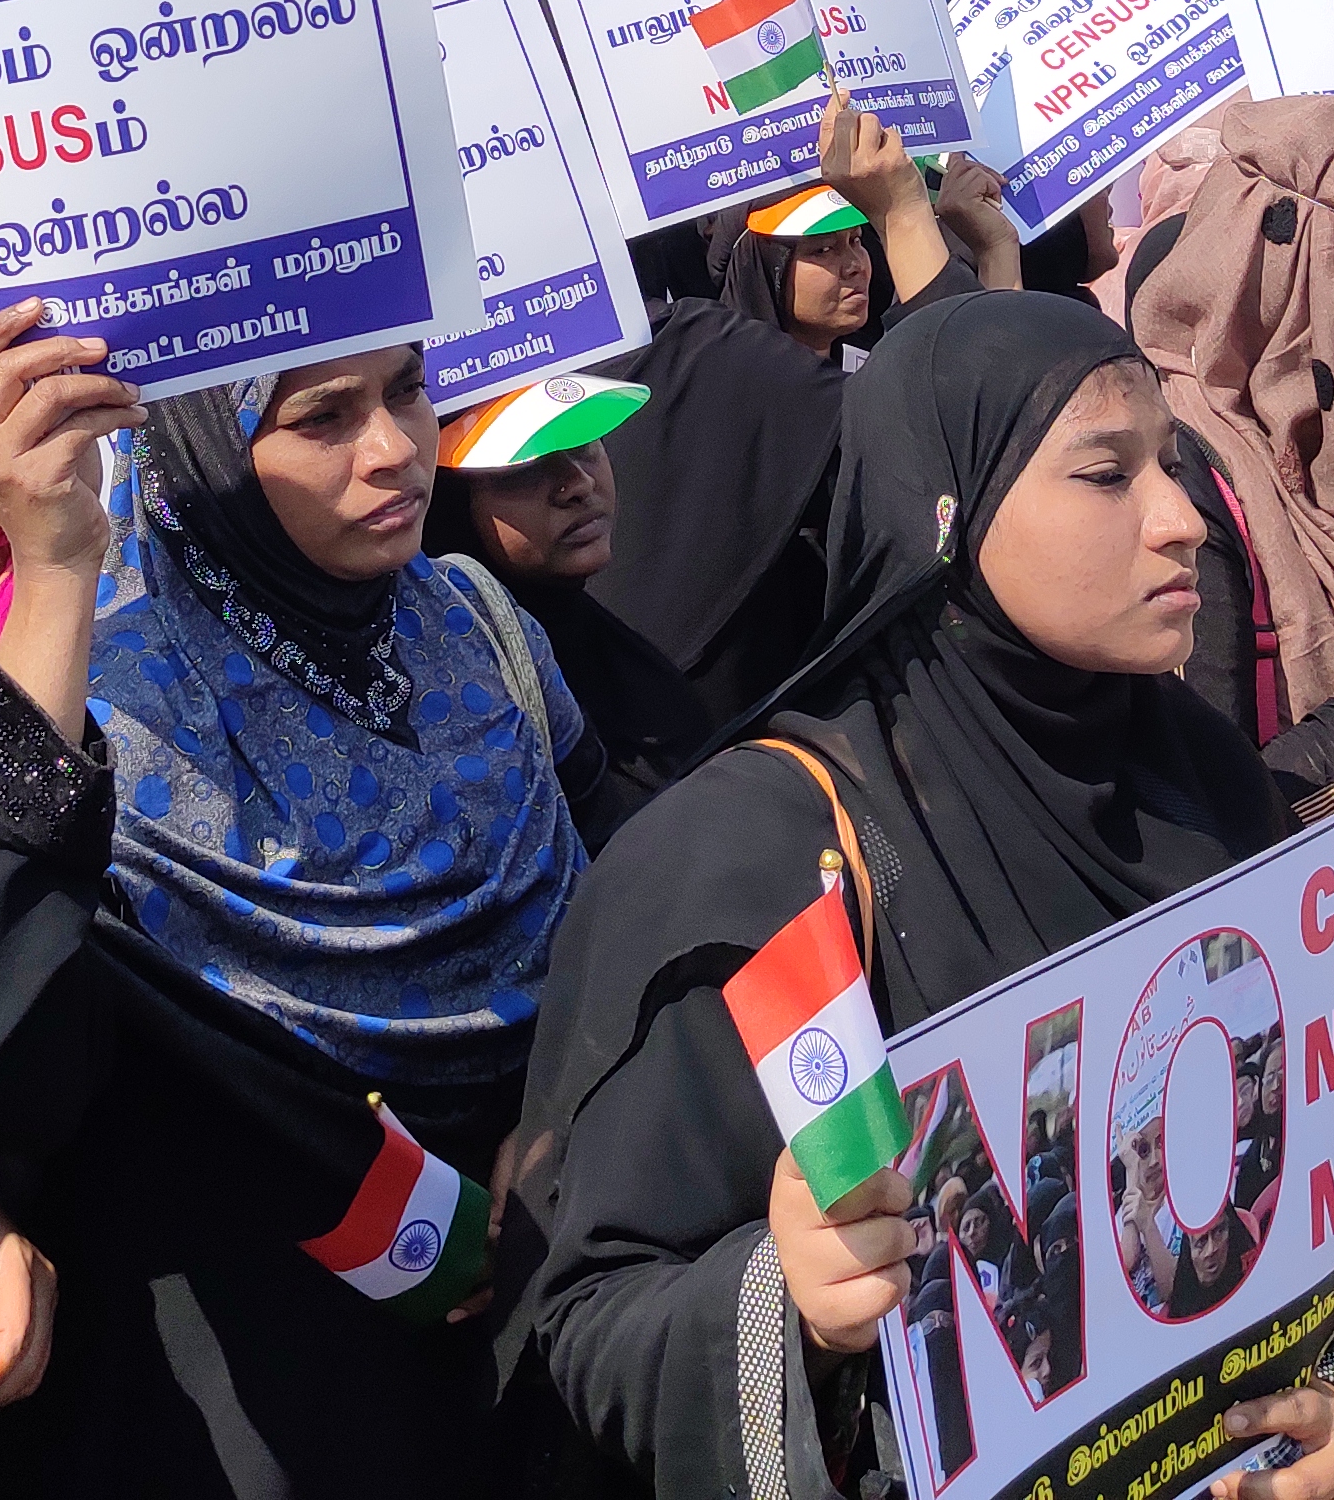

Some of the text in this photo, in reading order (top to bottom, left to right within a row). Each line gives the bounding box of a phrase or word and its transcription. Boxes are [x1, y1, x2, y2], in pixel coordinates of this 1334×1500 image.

[643, 83, 957, 181] தமிழ்நாடு மற்றும்
[1033, 61, 1118, 123] NPRம்
[1066, 80, 1203, 186] அரசியல் கட்சிகளின்
[706, 154, 781, 190] அரசியல்
[1007, 76, 1163, 197] தமிழ்நாடு இஸ்லாமிய
[31, 251, 253, 336] இயக்கங்கள்
[271, 220, 405, 288] மற்றும்
[523, 272, 599, 318] மற்றும்
[106, 300, 313, 376] கூட்டமைப்பு
[436, 329, 555, 389] கூட்டமைப்பு
[1066, 1372, 1205, 1487] இஸ்லாமிய
